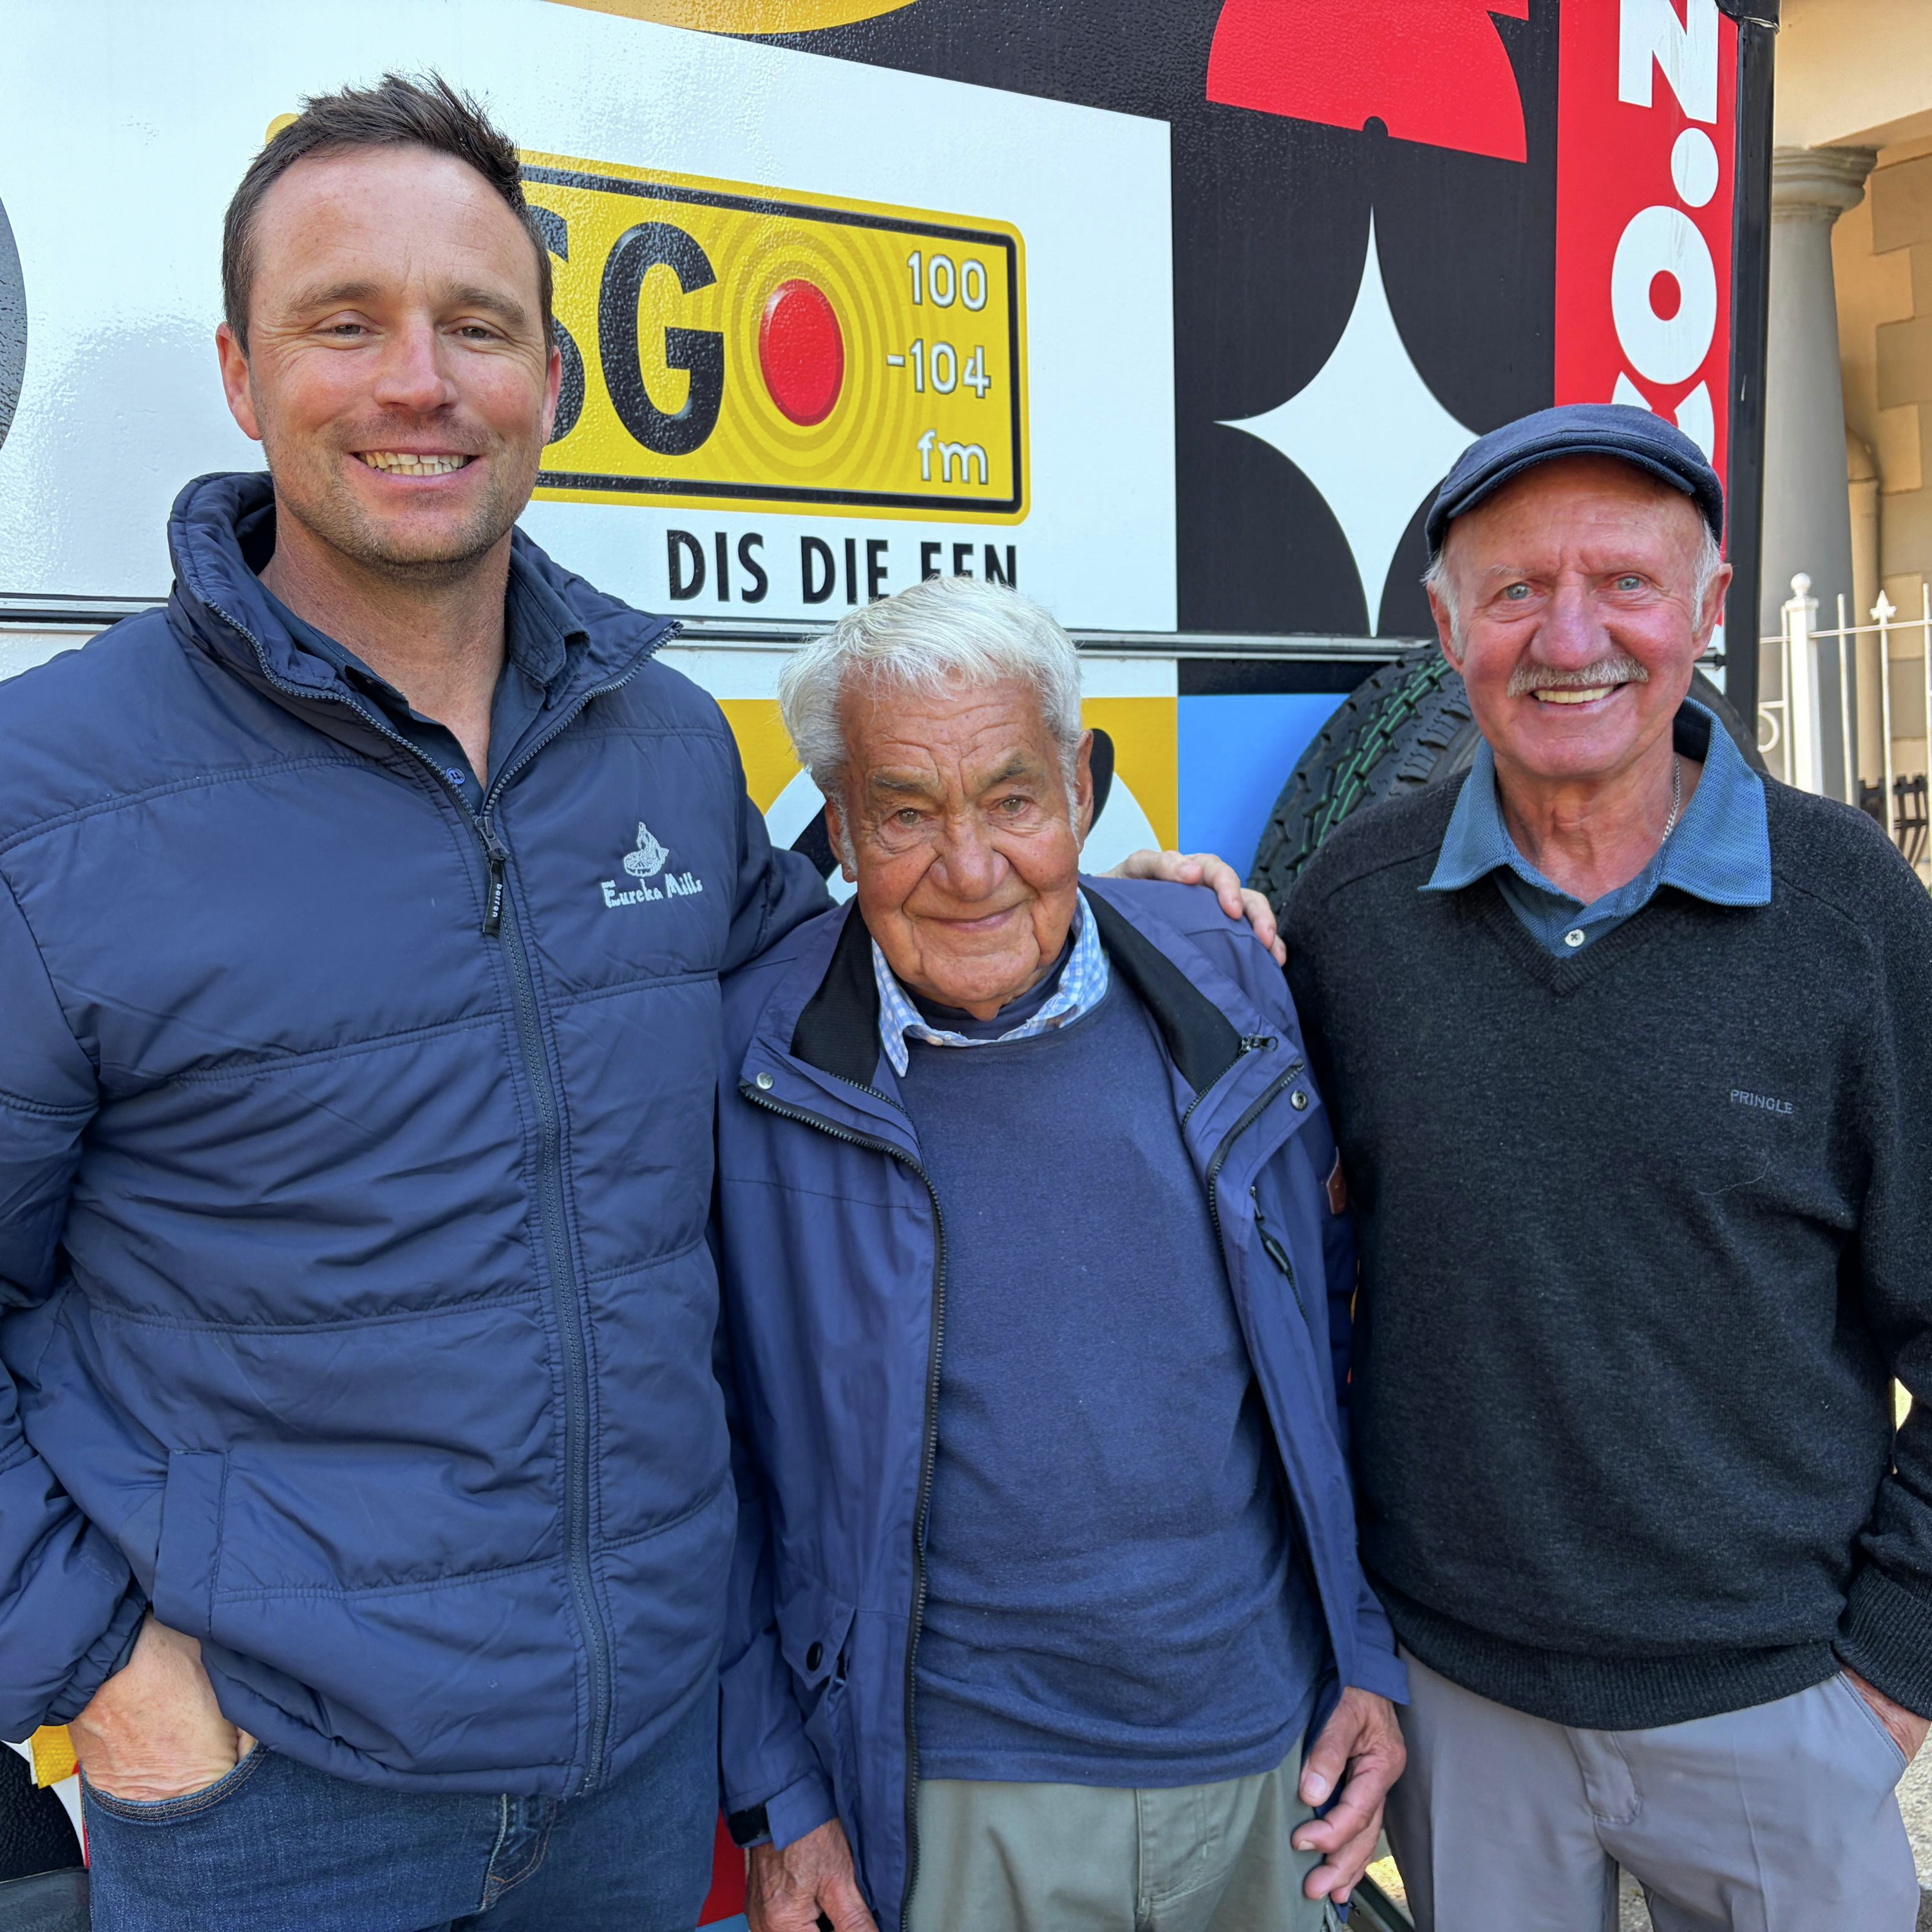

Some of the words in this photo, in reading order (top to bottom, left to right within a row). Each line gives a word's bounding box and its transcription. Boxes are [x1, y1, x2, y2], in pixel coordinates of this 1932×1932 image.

[907, 250, 988, 312] 100
[886, 337, 992, 399] -104
[917, 428, 989, 484] fm
[667, 529, 769, 604] DIS
[800, 535, 891, 605] DIE
[493, 883, 503, 918] barron
[601, 878, 664, 909] Eureka
[665, 871, 703, 898] Mills
[1730, 1089, 1795, 1115] PRINGLE
